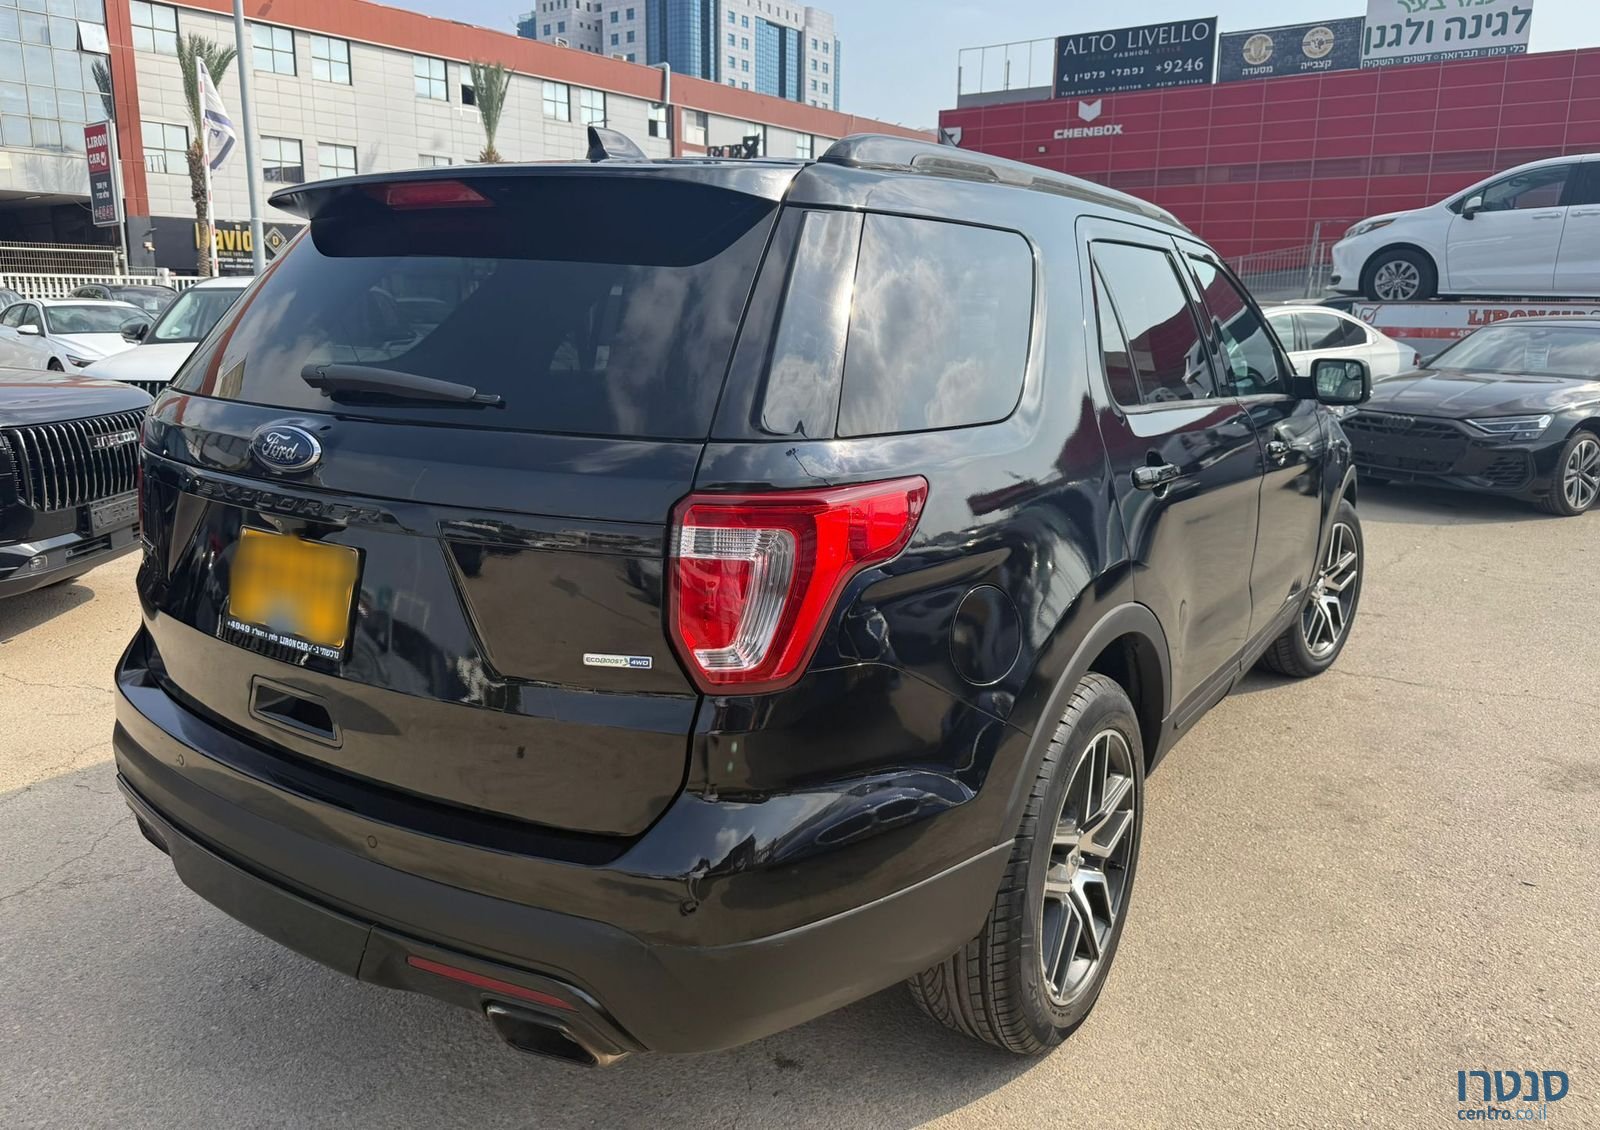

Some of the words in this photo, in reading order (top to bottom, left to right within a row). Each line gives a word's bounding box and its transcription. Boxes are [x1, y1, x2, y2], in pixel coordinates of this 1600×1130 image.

[1444, 5, 1533, 41] לגינה
[1063, 33, 1116, 56] ALTO
[1127, 22, 1210, 49] LIVELLO
[1363, 17, 1434, 56] ולגנן
[1509, 44, 1526, 53] כלי
[1300, 59, 1332, 70] קצבייה
[1363, 58, 1395, 68] השקיה
[1402, 54, 1432, 64] דשנים
[1242, 65, 1273, 76] מסעדה
[1053, 124, 1123, 139] CHENBOX
[87, 134, 107, 149] LIRON
[89, 151, 101, 165] CAR
[262, 432, 300, 460] Ford
[279, 635, 296, 648] LIRON
[296, 641, 309, 652] CAR
